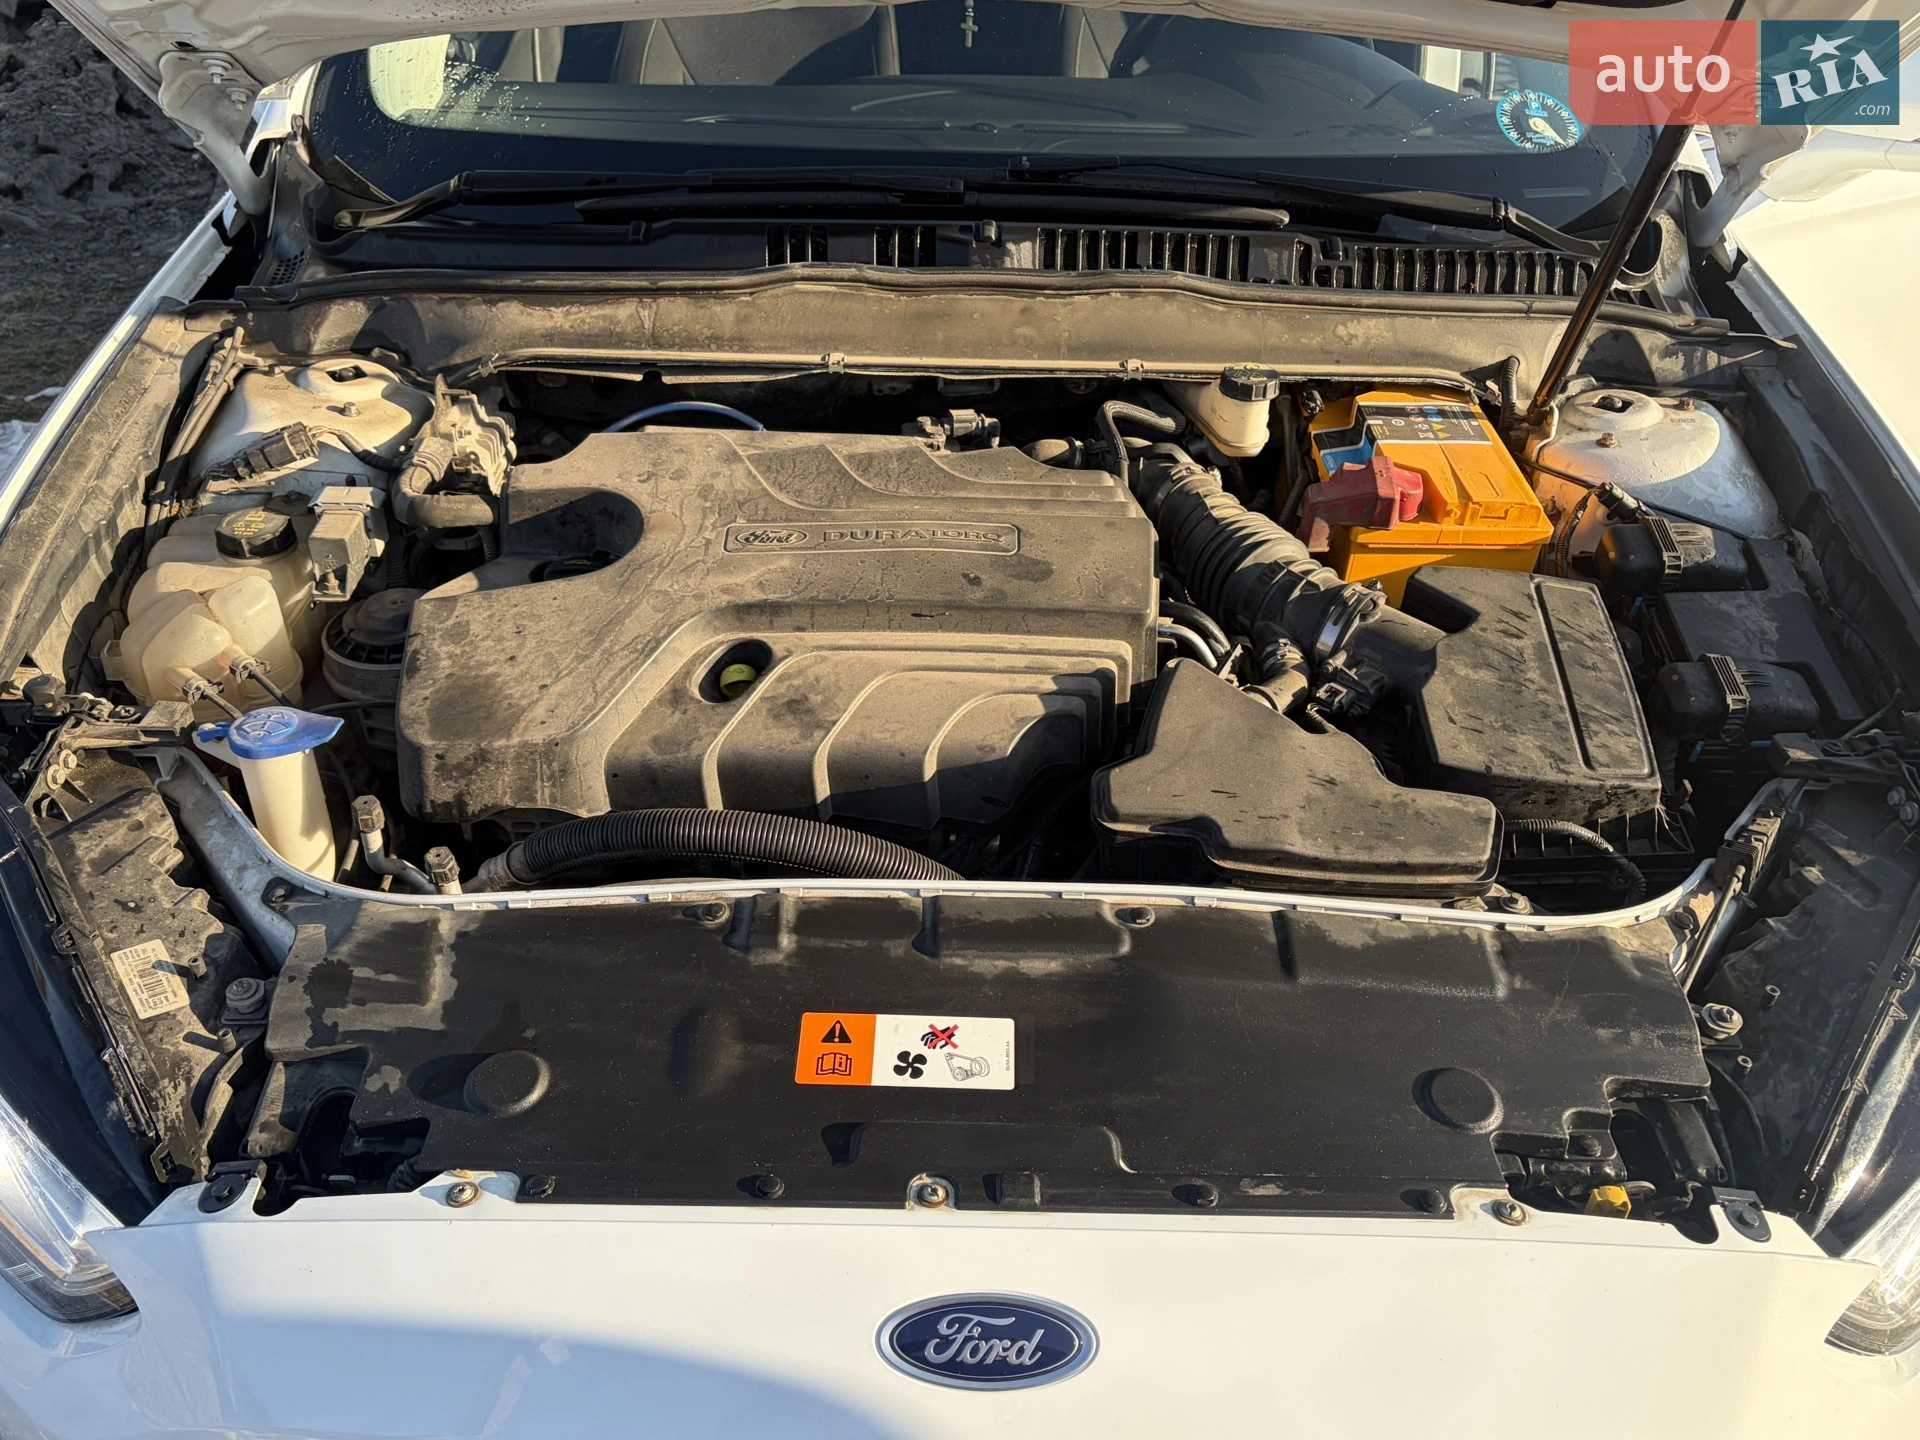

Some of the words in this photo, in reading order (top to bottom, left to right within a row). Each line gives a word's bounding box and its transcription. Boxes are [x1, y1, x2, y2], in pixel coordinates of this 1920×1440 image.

[744, 529, 798, 544] Ford
[822, 528, 1005, 543] DURATORQ
[924, 1313, 1045, 1366] Ford
